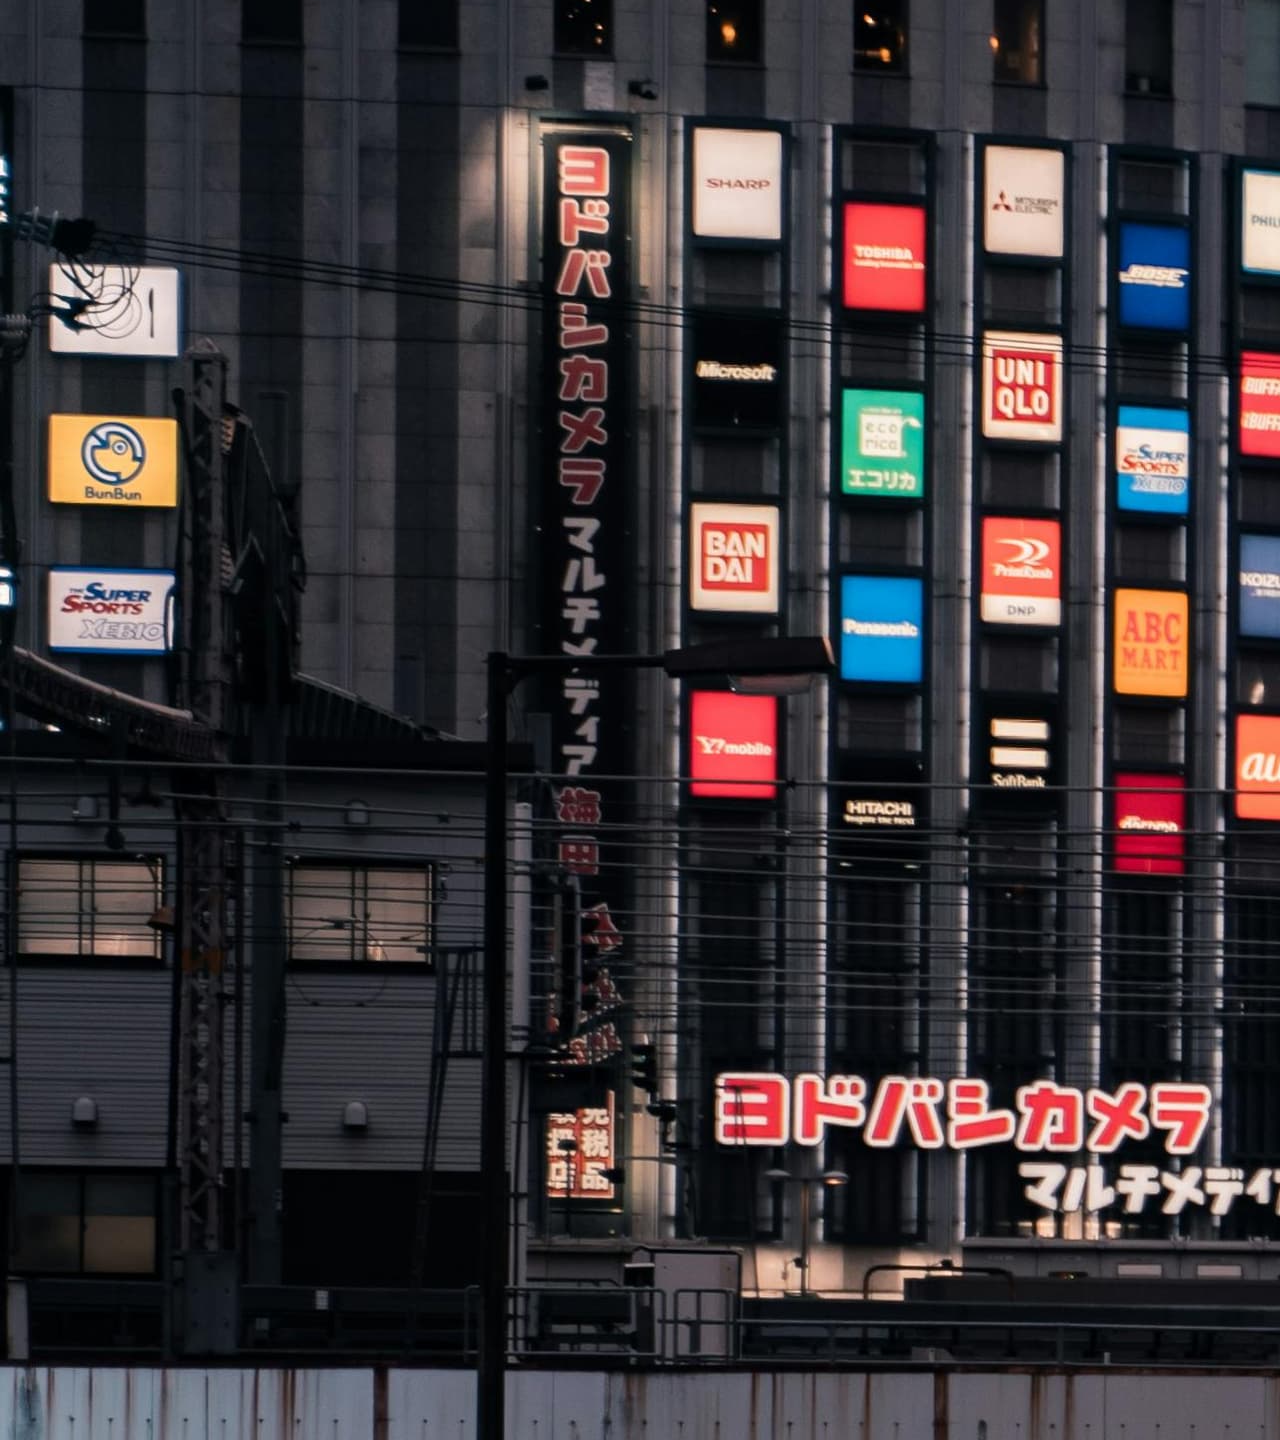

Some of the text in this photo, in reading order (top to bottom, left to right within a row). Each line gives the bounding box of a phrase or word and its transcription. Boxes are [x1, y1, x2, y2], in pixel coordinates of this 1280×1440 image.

[705, 178, 770, 190] SHARP
[854, 245, 913, 261] TOSHIBA
[1120, 264, 1189, 287] BOSE
[696, 361, 776, 381] Microsoft
[997, 358, 1046, 388] UNI
[998, 386, 1050, 417] QLO
[1138, 444, 1185, 462] SUPER
[1122, 455, 1179, 475] SPORTS
[849, 469, 916, 491] エコリカ
[85, 486, 142, 500] BunBun
[704, 530, 766, 559] BAN
[705, 557, 752, 583] DAI
[83, 582, 152, 603] SUPER
[61, 595, 144, 615] SPORTS
[1007, 605, 1036, 616] DNP
[79, 618, 166, 641] XEBIO
[843, 618, 919, 638] Panasonic
[1122, 610, 1181, 645] ABC
[1121, 647, 1182, 672] MART
[992, 773, 1046, 788] SoftBank
[846, 800, 912, 816] HITACHI
[715, 1072, 1212, 1153] ヨドバシカメラ
